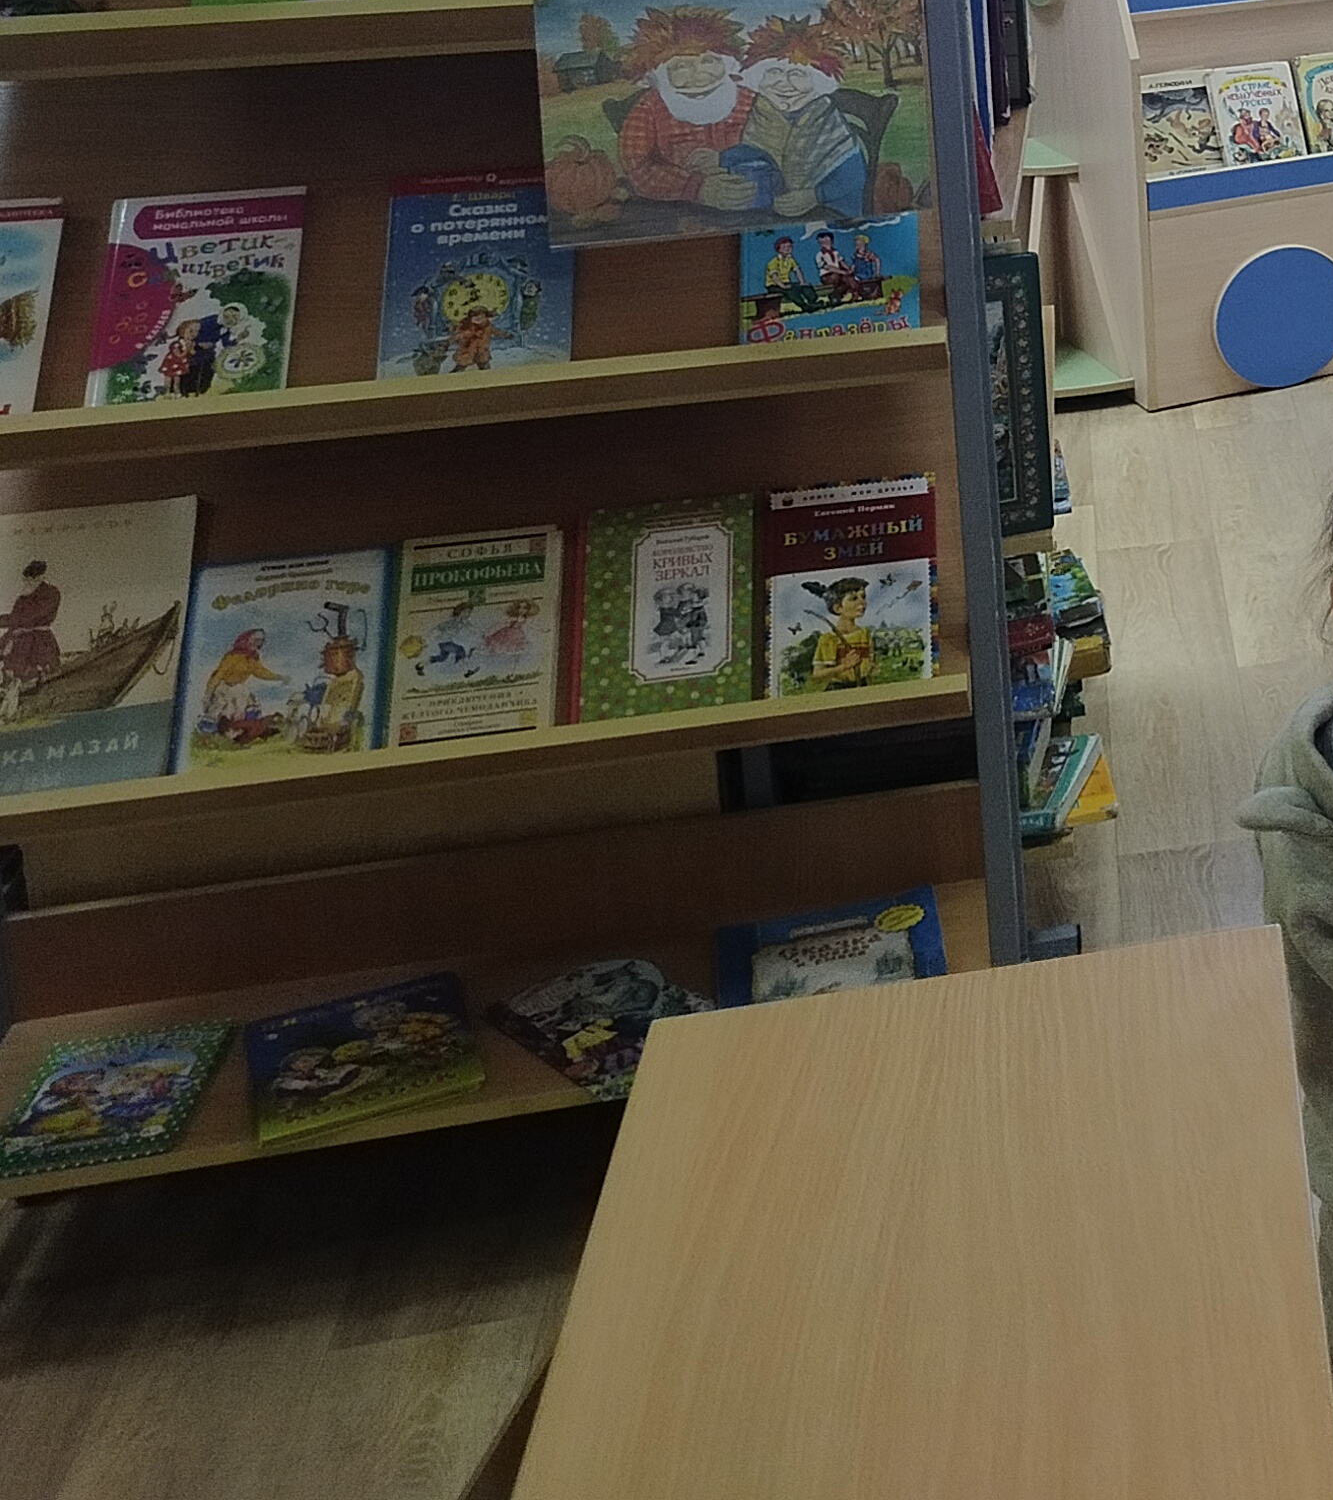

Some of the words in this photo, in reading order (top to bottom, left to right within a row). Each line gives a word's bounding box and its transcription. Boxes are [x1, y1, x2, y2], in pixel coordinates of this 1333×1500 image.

[154, 205, 245, 220] Библиотека
[449, 203, 518, 217] Сказка
[153, 216, 234, 231] начальной
[238, 213, 288, 225] школы
[411, 223, 425, 234] о
[437, 228, 526, 246] времени
[784, 514, 924, 547] БУМАЖНЫЙ
[447, 543, 513, 559] СОФЬЯ
[823, 537, 884, 561] ЗМЕЙ
[653, 552, 714, 569] КРИВЫХ
[414, 561, 543, 588] ПРОКОФЬЕВА
[655, 565, 710, 581] ЗЕРКАЛ
[47, 731, 140, 761] МАЗАЙ
